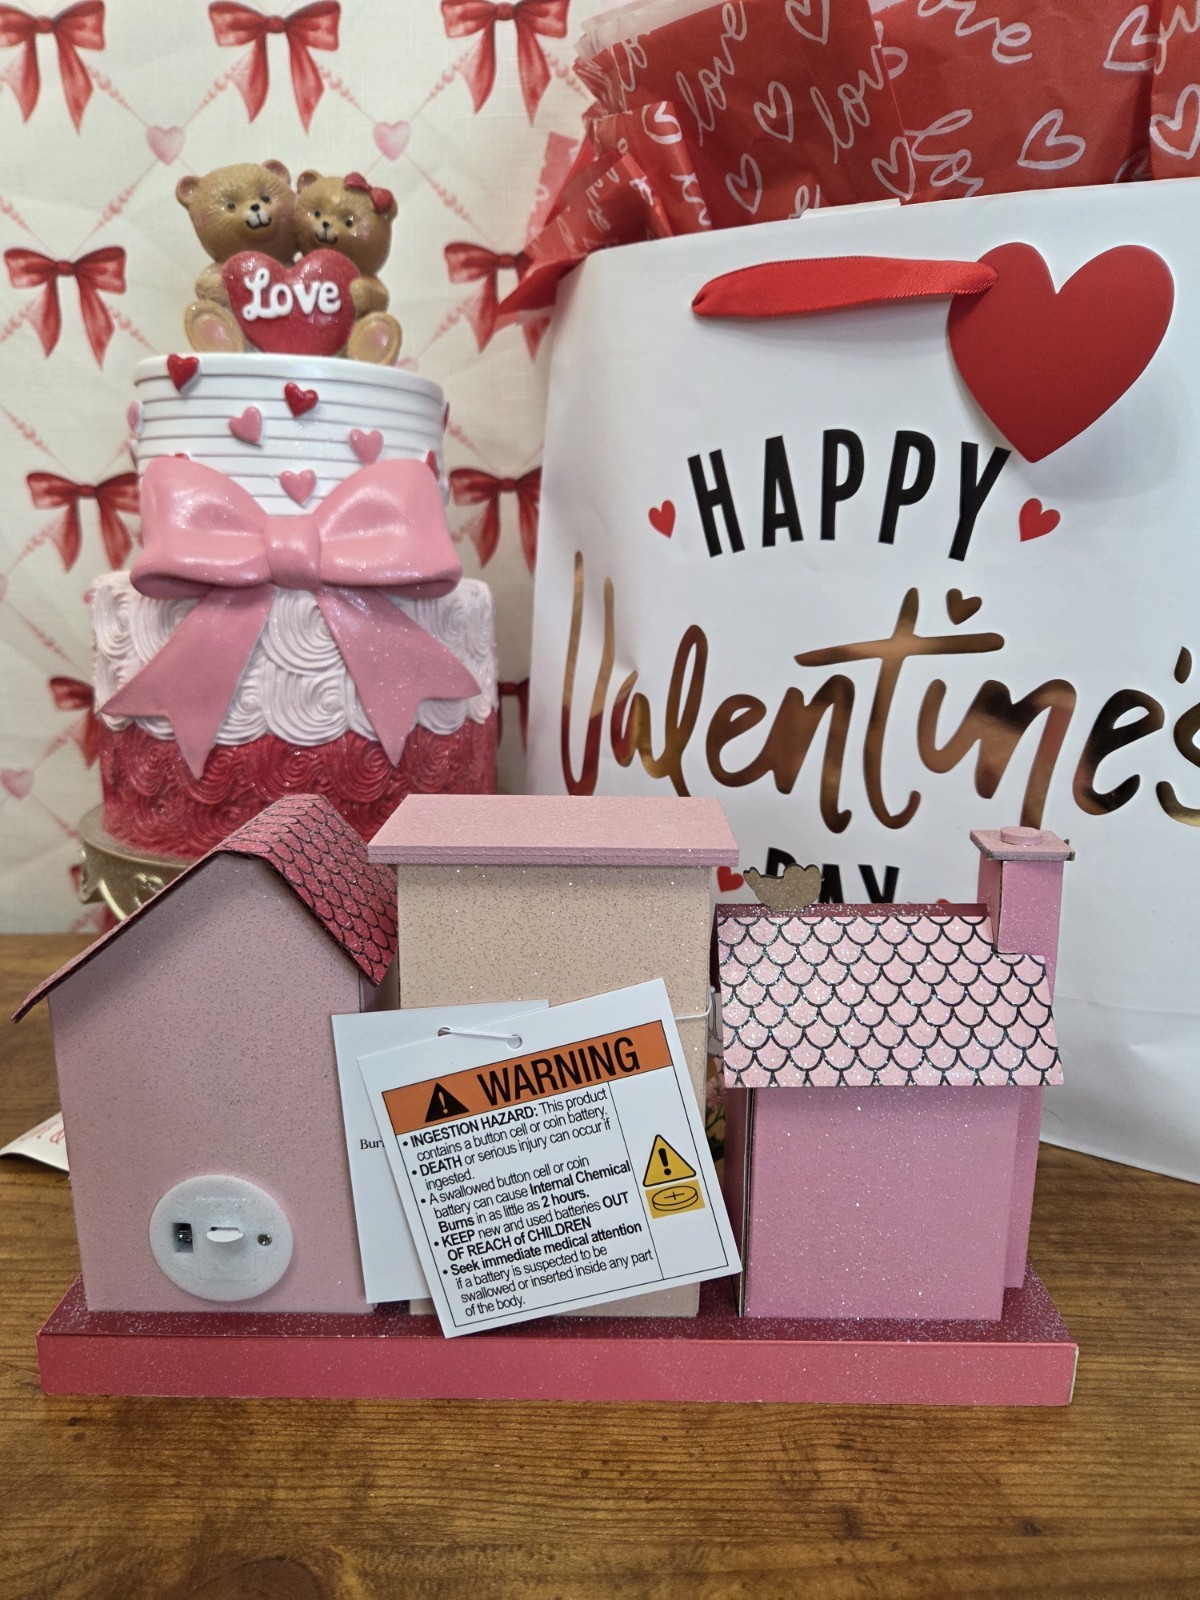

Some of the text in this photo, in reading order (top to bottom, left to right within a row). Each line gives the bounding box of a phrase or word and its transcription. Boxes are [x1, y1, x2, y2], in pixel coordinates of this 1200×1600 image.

[242, 268, 342, 321] Love
[688, 429, 1011, 561] HAPPY
[476, 1036, 641, 1106] WARNING
[410, 1088, 607, 1147] INGESTION HAZARD: This product
[417, 1106, 608, 1162] contains a button cell or coin battery.
[419, 1117, 611, 1176] DEATH or serious injury can occur if
[425, 1168, 475, 1191] ingested.
[429, 1156, 590, 1205] A swallowed button cell or coin
[433, 1160, 631, 1219] battery can cause Internal Chemical
[438, 1188, 590, 1233] Burns in as little as 2 hours.
[441, 1191, 629, 1248] KEEP new and used batteries OUT
[447, 1216, 592, 1261] OF REACH of CHILDREN
[450, 1223, 643, 1276] Seek immediate medical attention
[455, 1245, 608, 1289] if a battery is suspected to be
[460, 1248, 653, 1304] swallowed or inserted inside any part
[465, 1294, 526, 1317] of the body.
